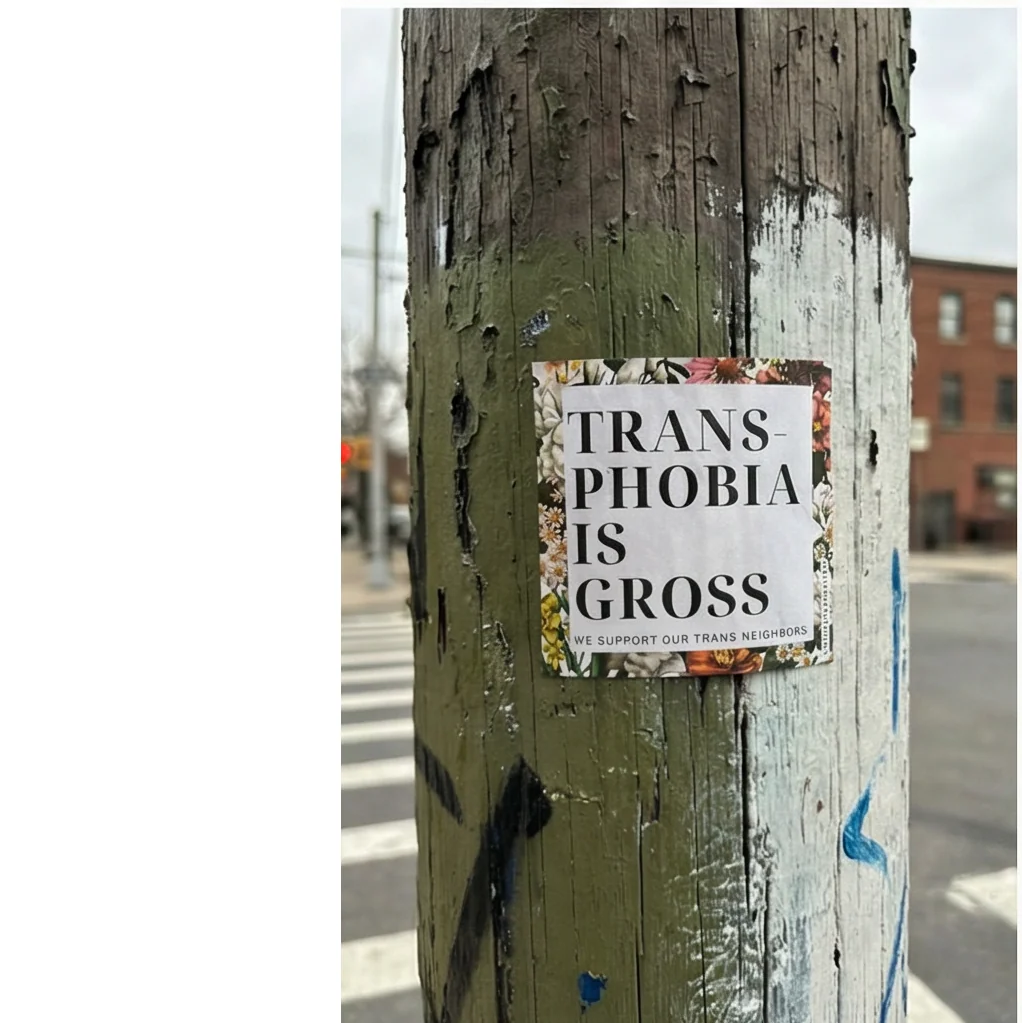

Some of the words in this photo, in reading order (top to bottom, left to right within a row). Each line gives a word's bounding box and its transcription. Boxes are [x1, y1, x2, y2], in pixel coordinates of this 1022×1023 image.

[567, 408, 787, 454] TRANS-
[570, 463, 800, 510] PHOBIA
[572, 522, 626, 566] IS
[576, 572, 769, 620] GROSS
[574, 635, 592, 646] WE
[597, 635, 657, 646] SUPPORT
[662, 634, 688, 645] OUR
[694, 632, 736, 644] TRANS
[742, 626, 808, 642] NEIGHBORS
